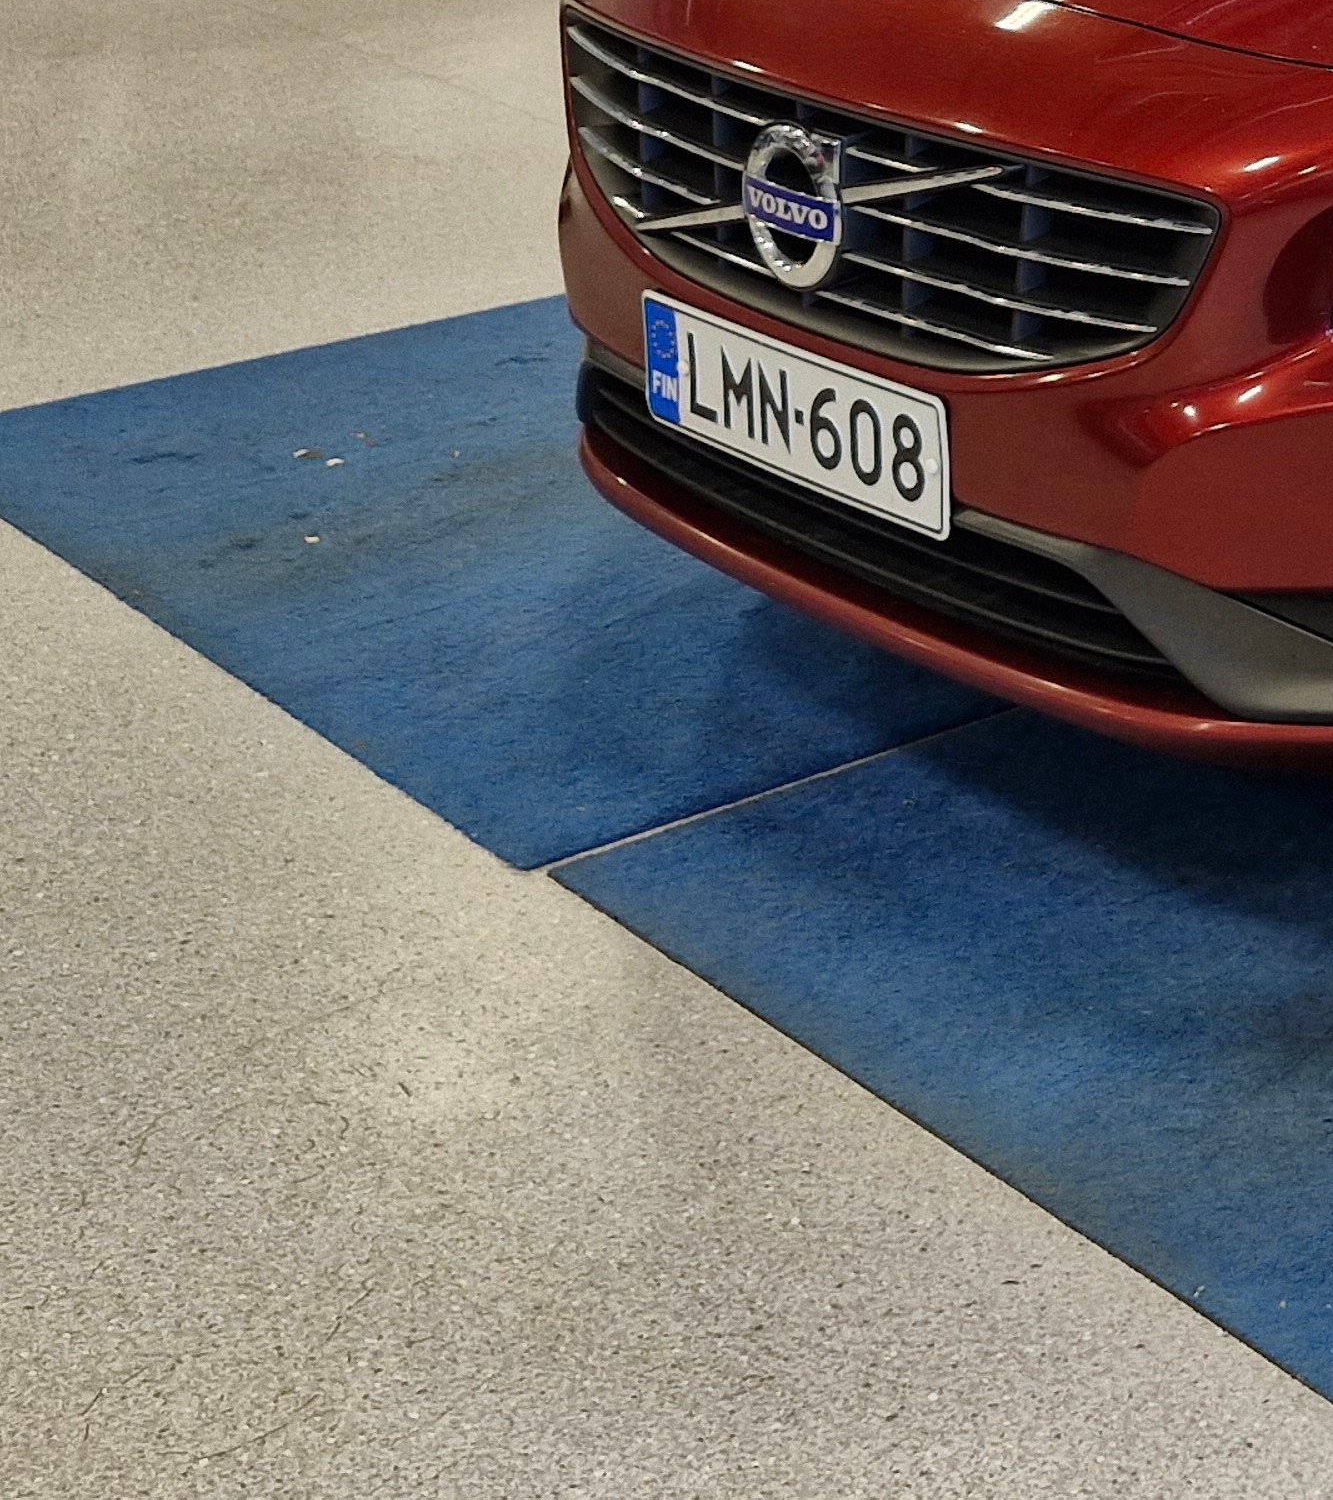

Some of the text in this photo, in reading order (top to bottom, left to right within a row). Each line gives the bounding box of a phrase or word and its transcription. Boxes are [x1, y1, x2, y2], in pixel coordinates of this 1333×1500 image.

[747, 188, 829, 231] VOLVO
[652, 371, 680, 404] FIN
[686, 331, 926, 503] LMN-608
